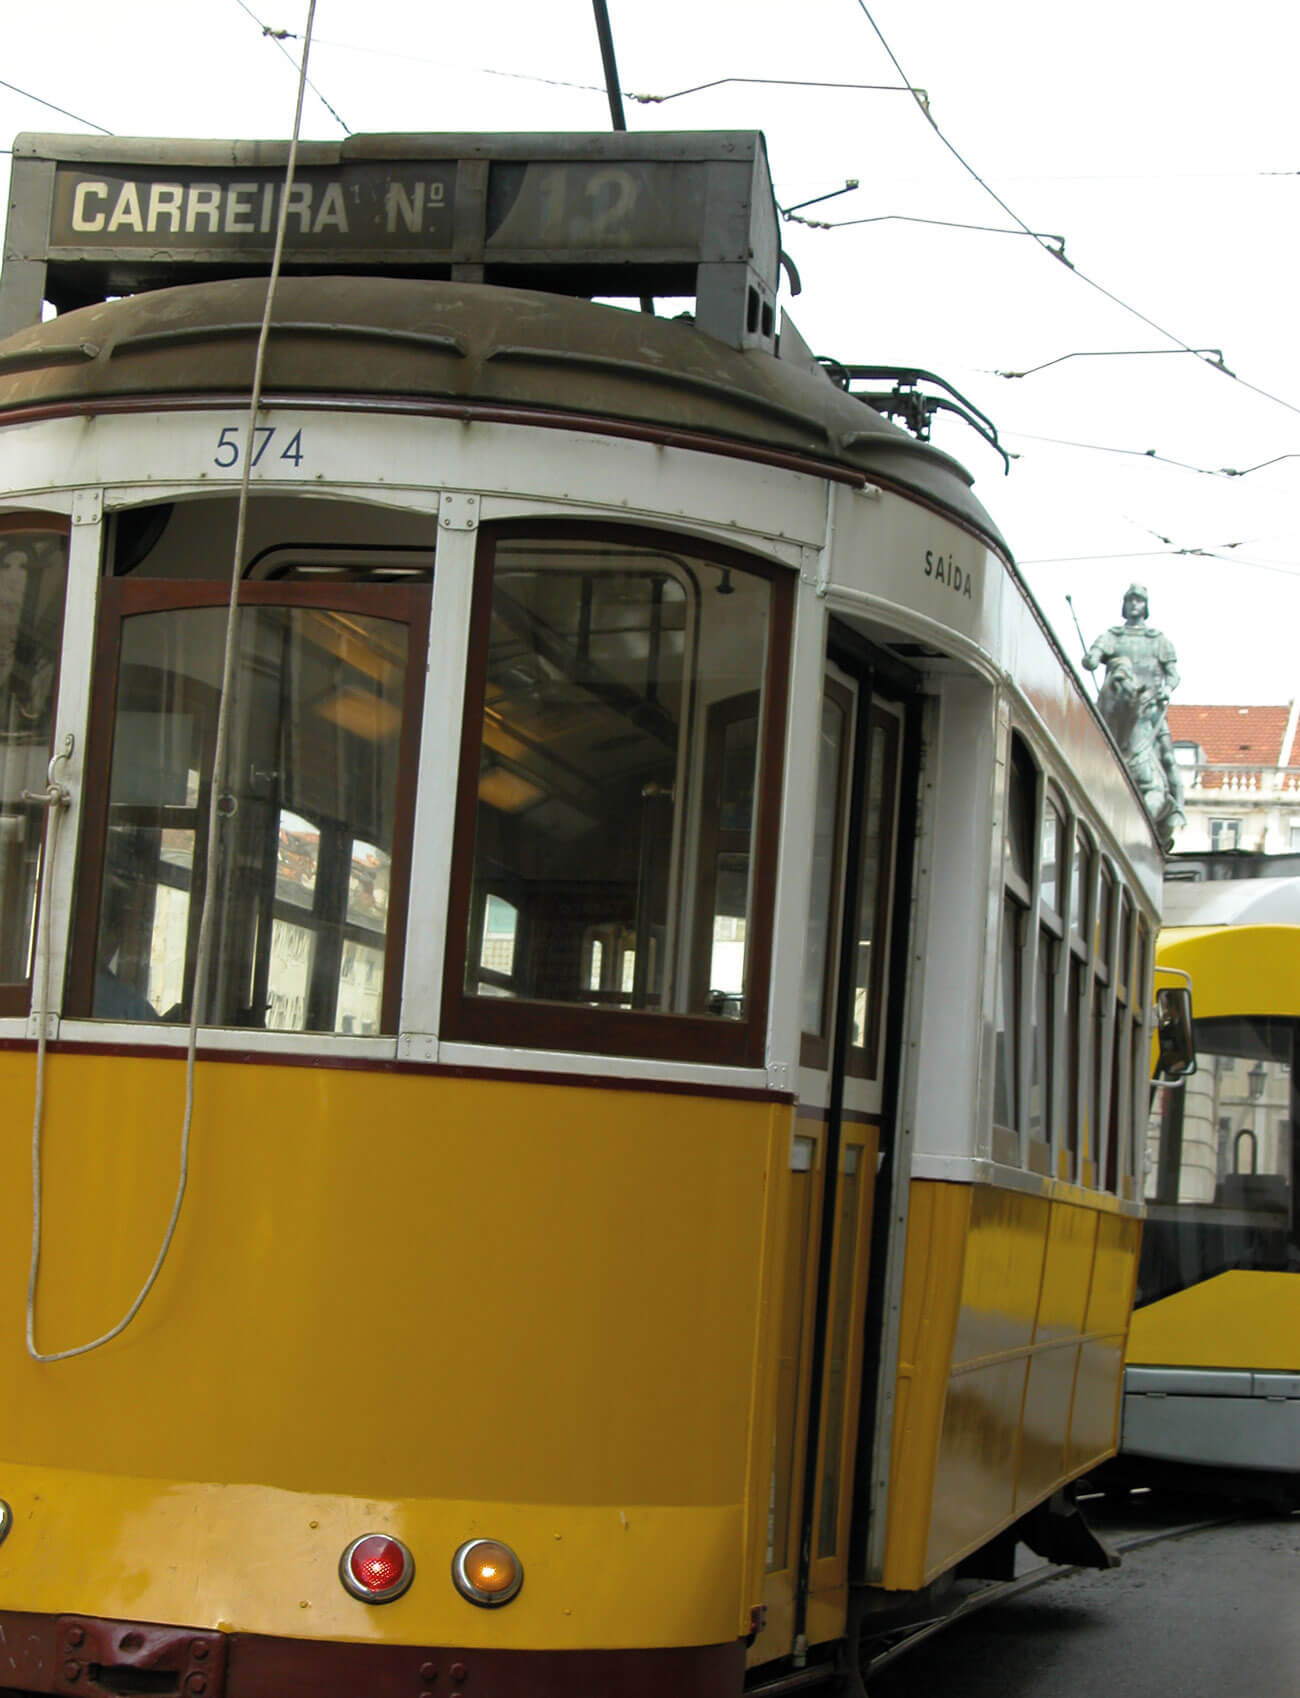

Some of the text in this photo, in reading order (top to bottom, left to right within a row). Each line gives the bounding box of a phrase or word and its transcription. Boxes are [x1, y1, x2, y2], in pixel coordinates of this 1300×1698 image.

[72, 181, 349, 233] CARREIRA
[538, 168, 638, 243] 12
[214, 427, 304, 468] 574
[924, 549, 972, 601] SAÍDA
